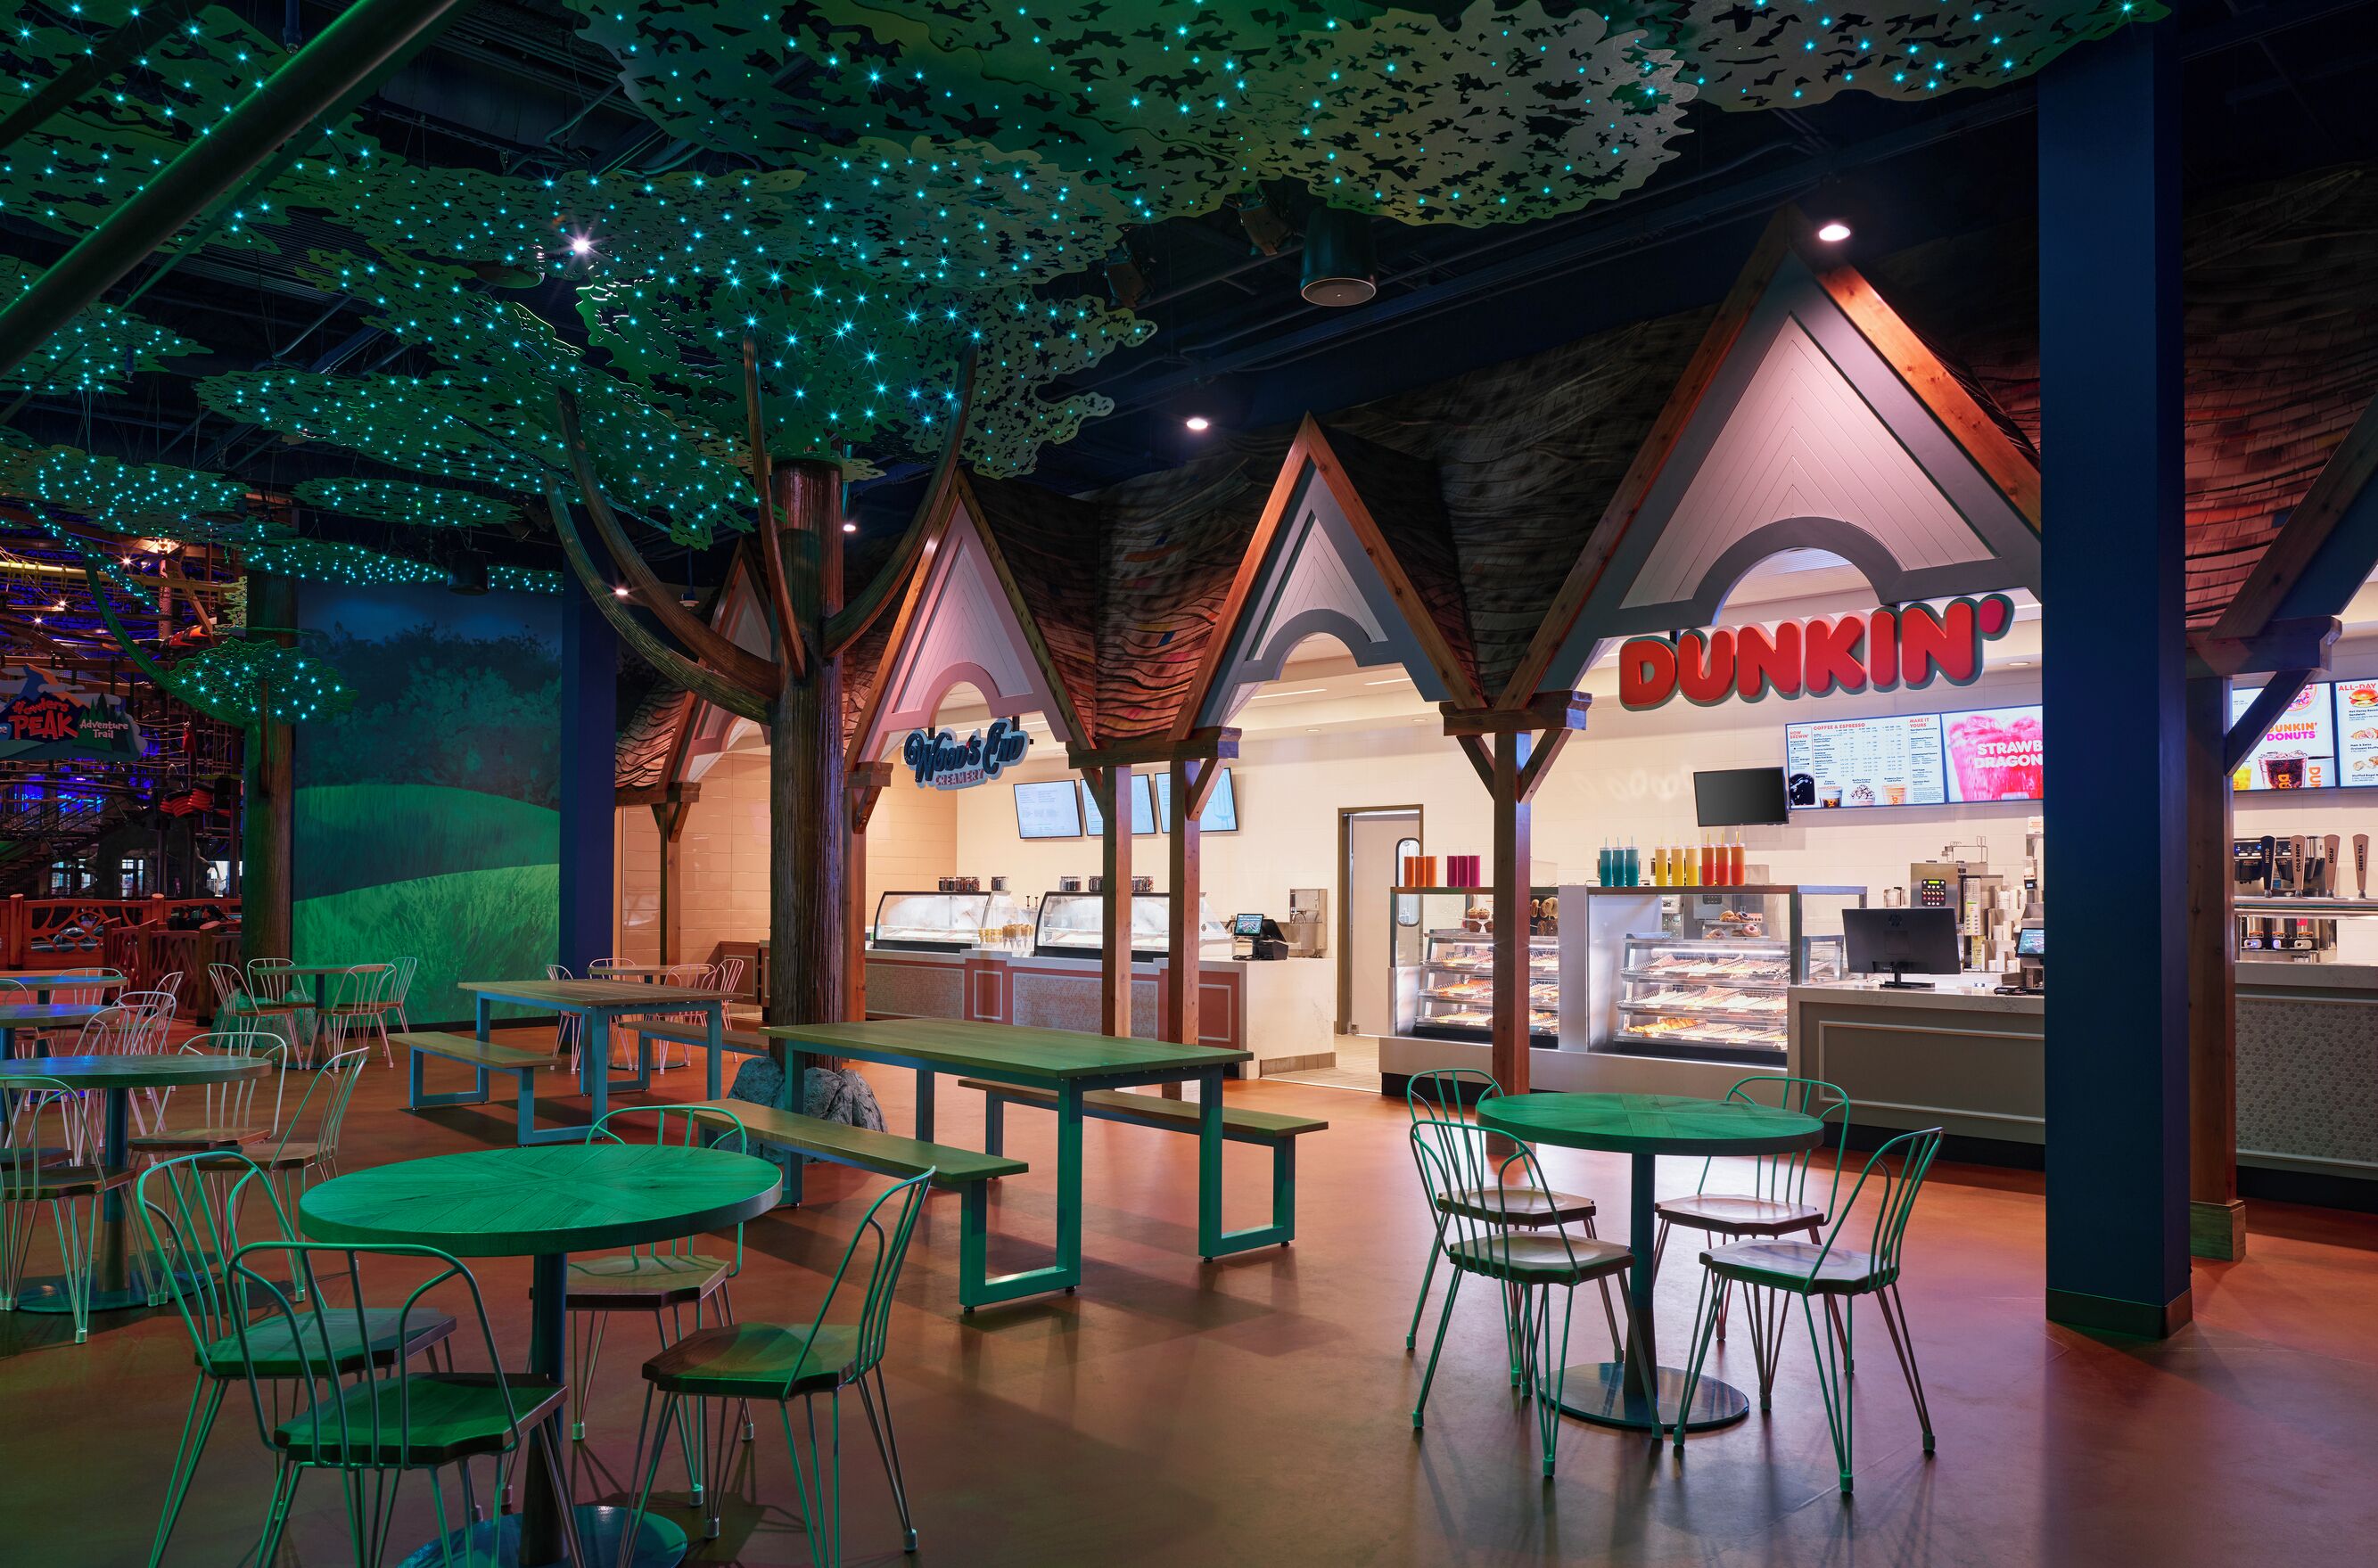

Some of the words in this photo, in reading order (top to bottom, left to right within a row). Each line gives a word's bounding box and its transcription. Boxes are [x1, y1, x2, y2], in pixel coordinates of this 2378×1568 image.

[1619, 596, 2013, 709] DUNKIN'
[8, 710, 79, 740] PEAK
[79, 718, 129, 730] Adventure
[93, 728, 114, 739] Trail
[2267, 730, 2316, 742] DONUTS
[1977, 740, 2043, 756] STRAWB
[1973, 754, 2043, 769] DRAGON
[935, 768, 985, 785] CREAMERY
